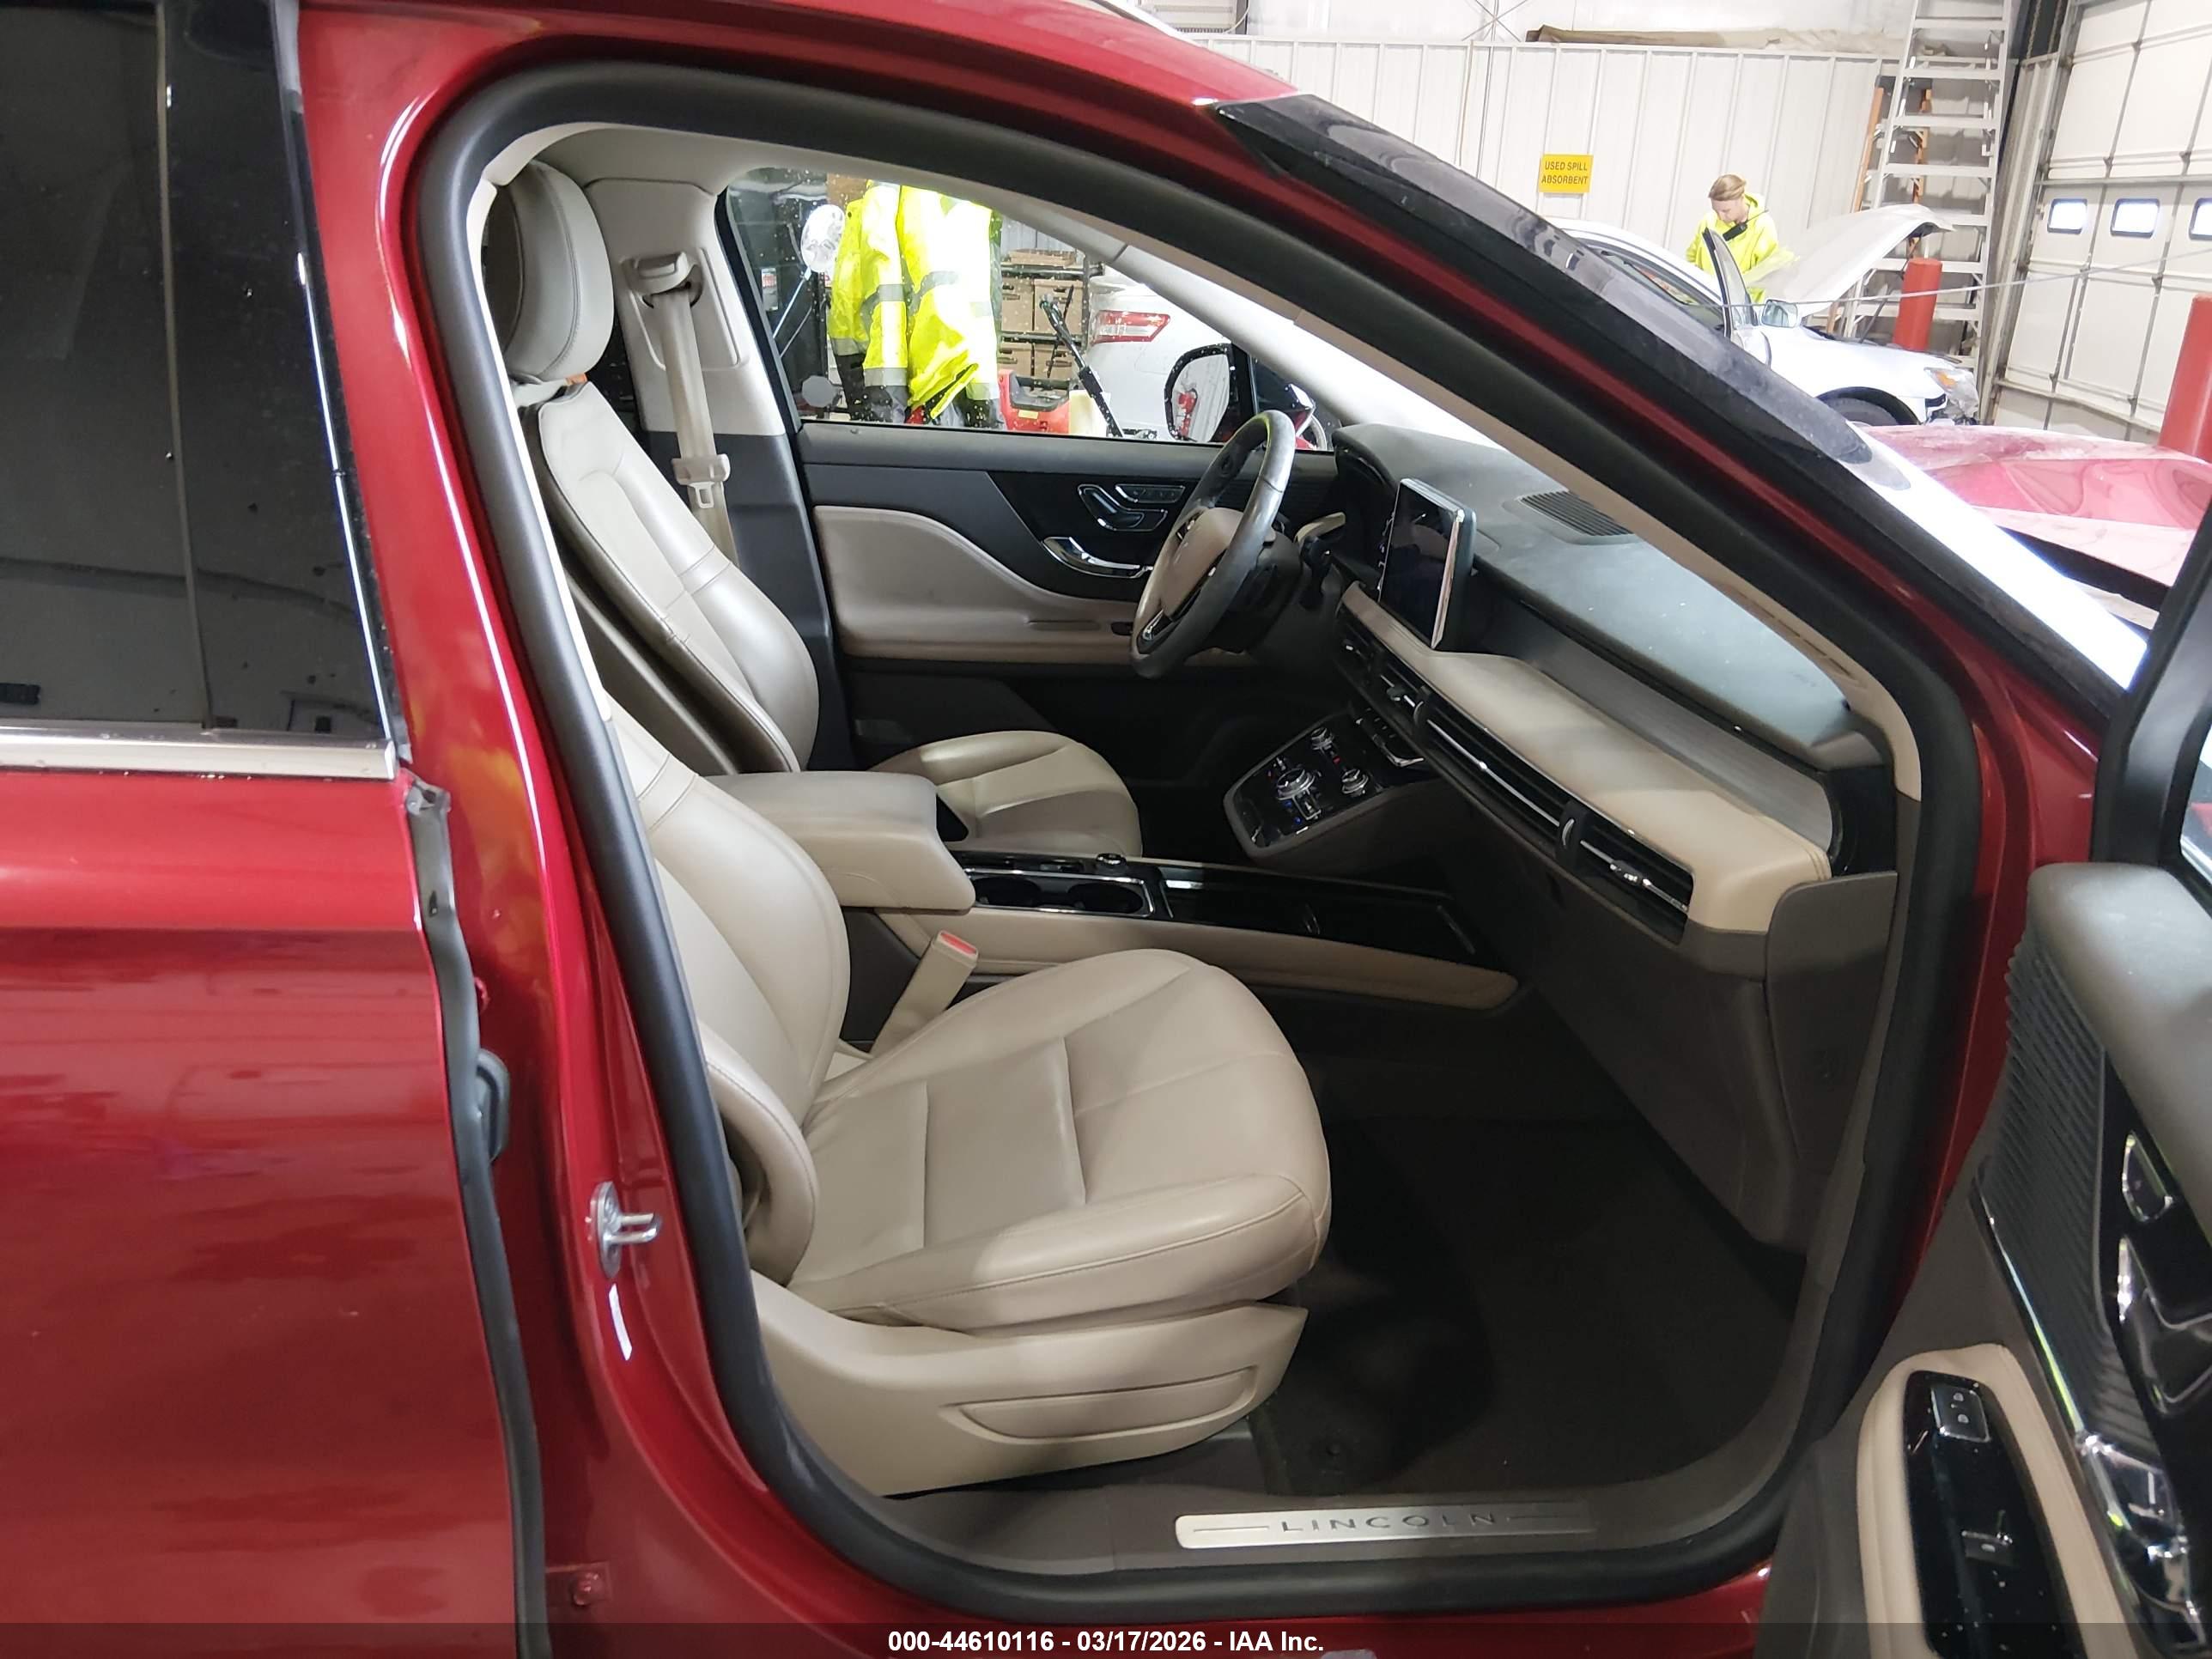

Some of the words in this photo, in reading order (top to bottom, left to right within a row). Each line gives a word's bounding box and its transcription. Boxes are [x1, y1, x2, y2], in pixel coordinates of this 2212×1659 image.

[1545, 161, 1565, 171] USED
[1566, 161, 1588, 172] SPILL
[1540, 174, 1589, 185] ABSORBENT
[1282, 1512, 1497, 1533] LINCOLN
